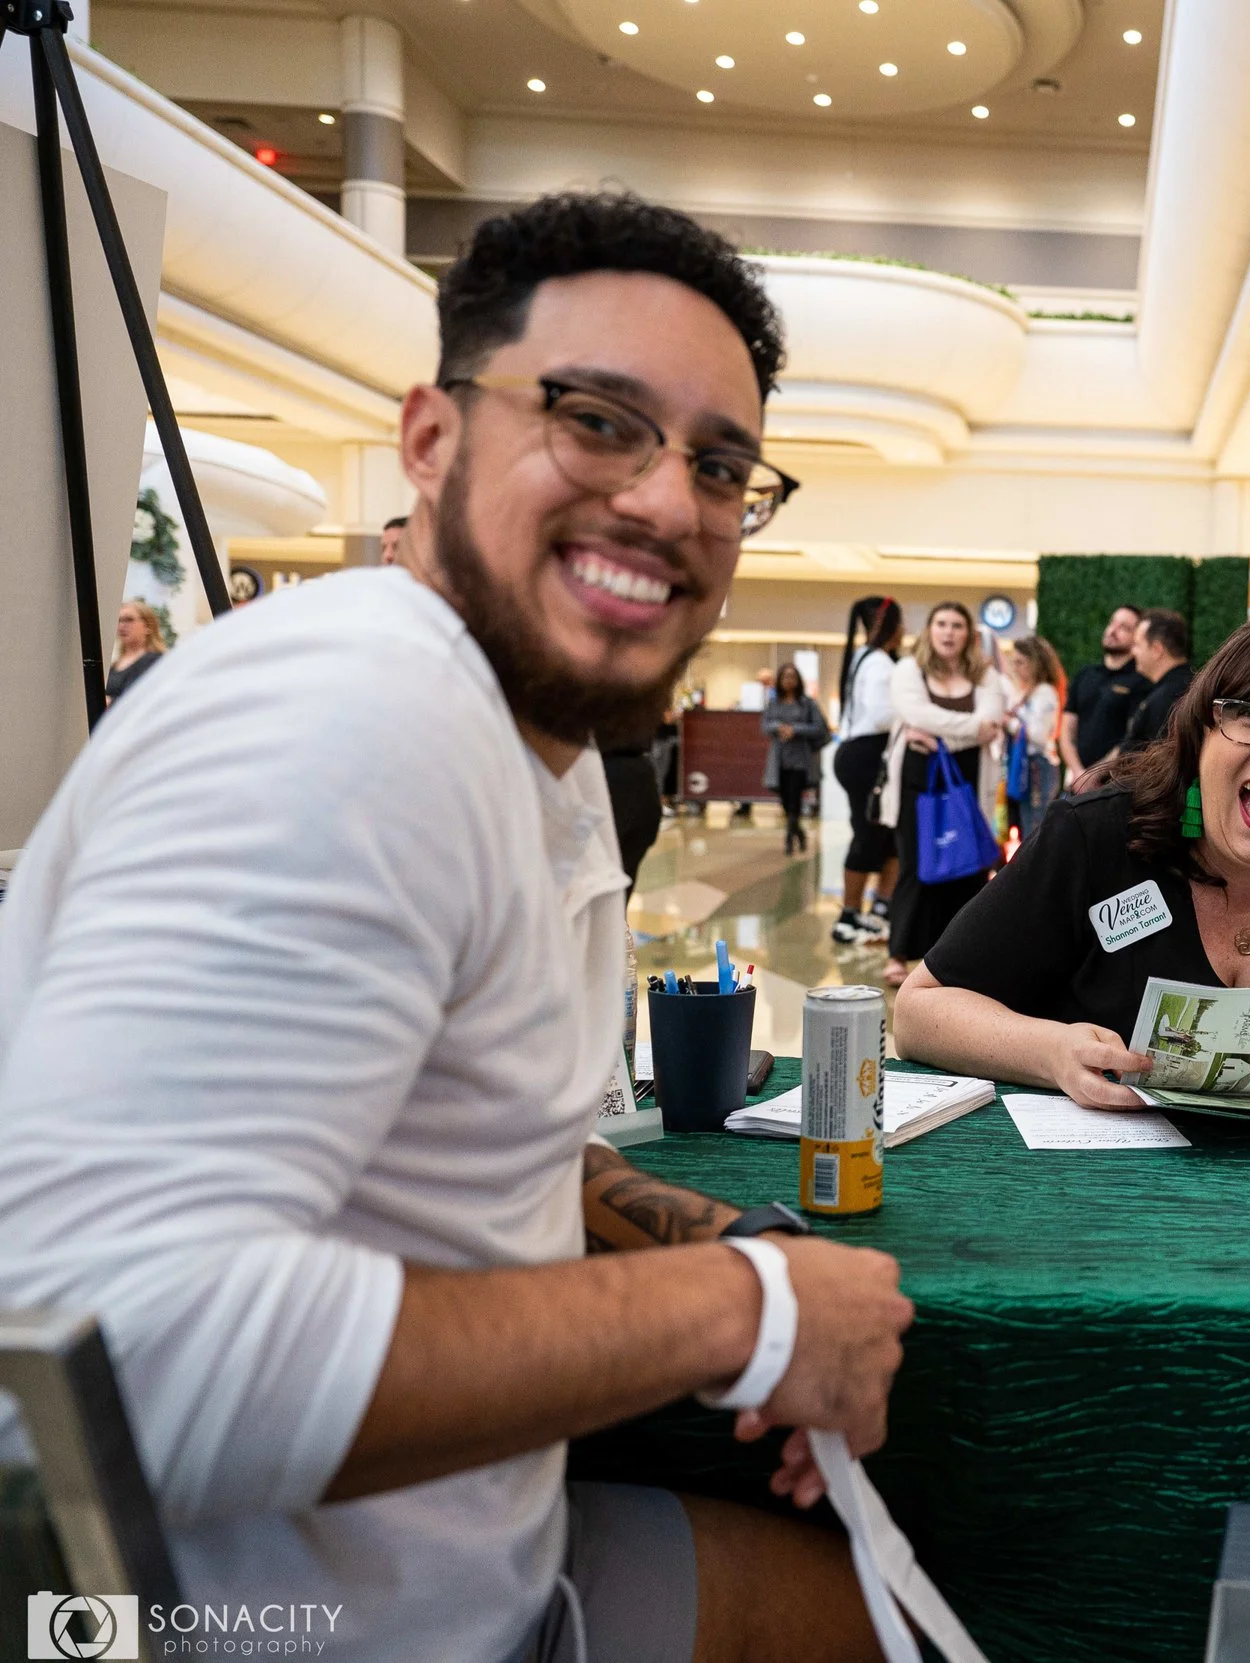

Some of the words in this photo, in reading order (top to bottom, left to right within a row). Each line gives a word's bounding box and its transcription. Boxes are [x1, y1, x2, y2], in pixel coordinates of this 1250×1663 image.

[1098, 894, 1153, 931] Venue
[1121, 888, 1149, 905] WEDDING
[1105, 925, 1139, 945] Shannon
[1138, 911, 1167, 929] Tarrant
